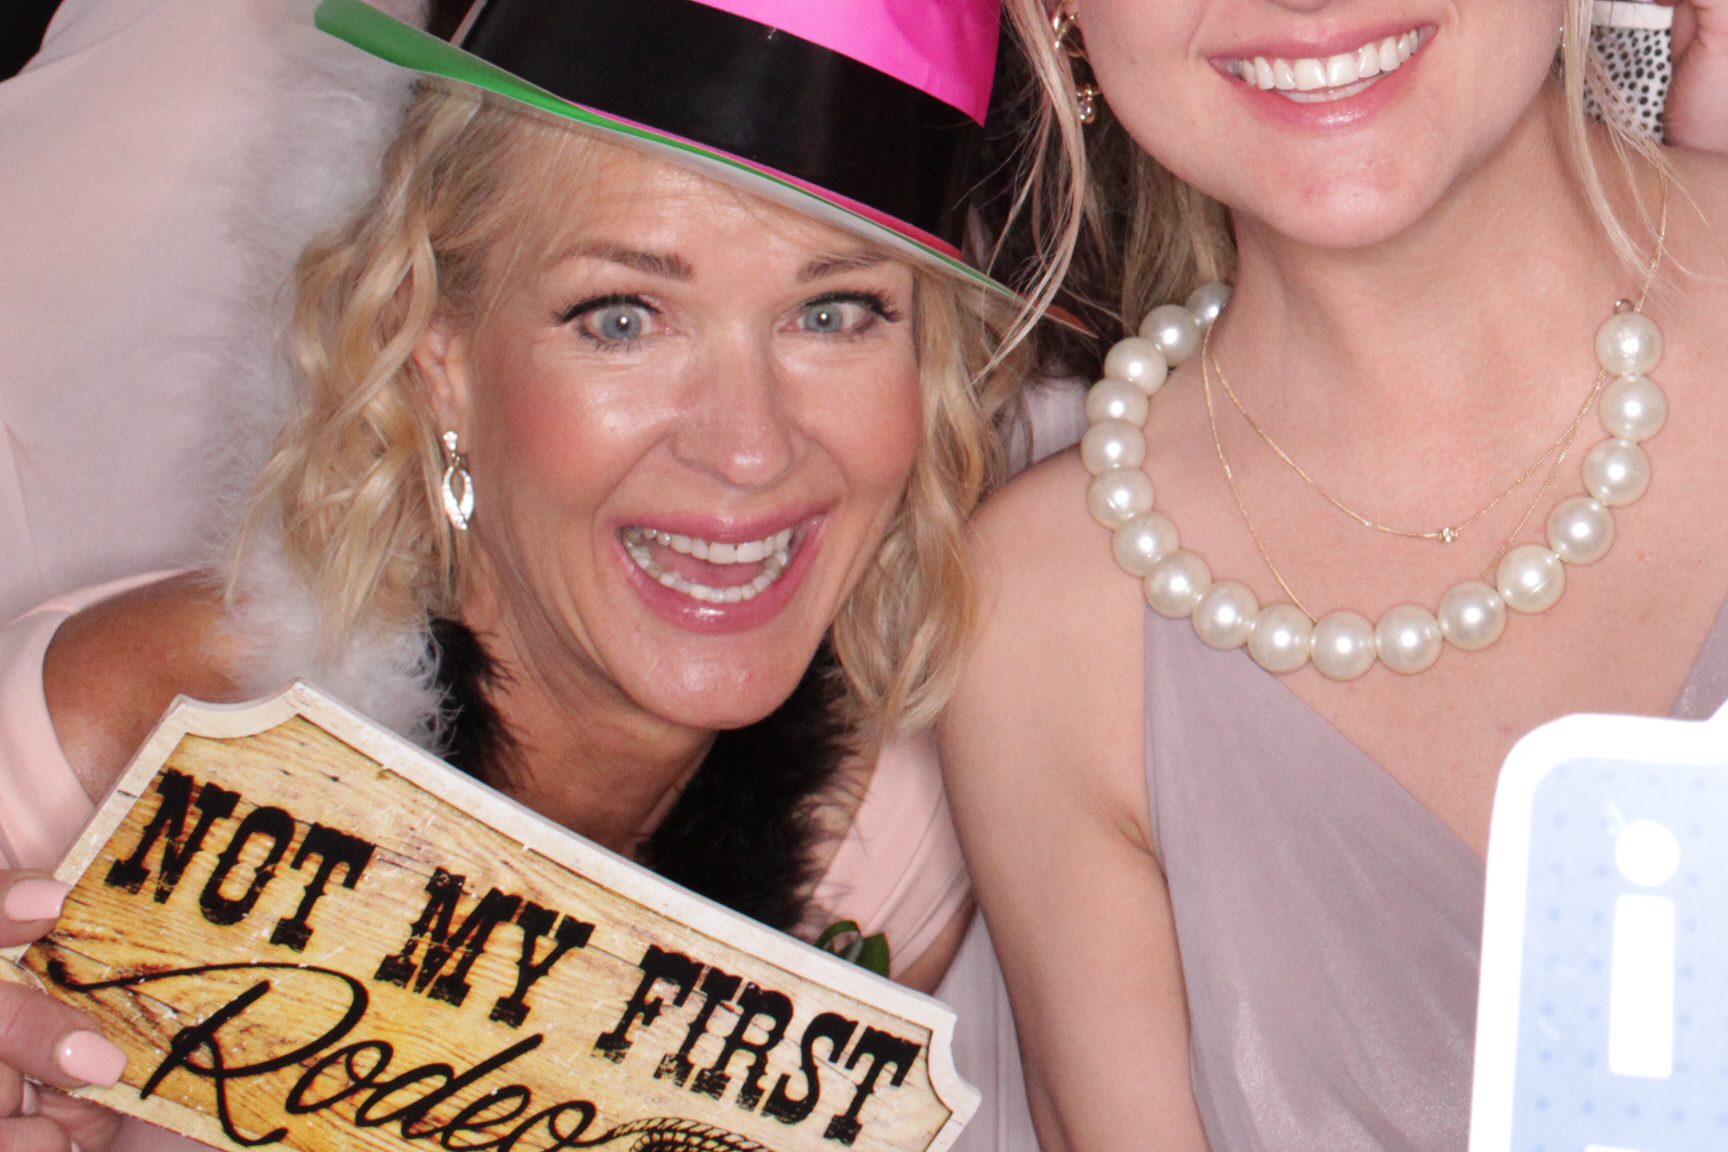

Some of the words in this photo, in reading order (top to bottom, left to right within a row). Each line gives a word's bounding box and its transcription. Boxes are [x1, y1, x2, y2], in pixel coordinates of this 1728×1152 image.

[47, 961, 605, 1152] Rodeo
[104, 768, 377, 953] NOT
[374, 866, 596, 1030] MY
[592, 943, 923, 1146] FIRST
